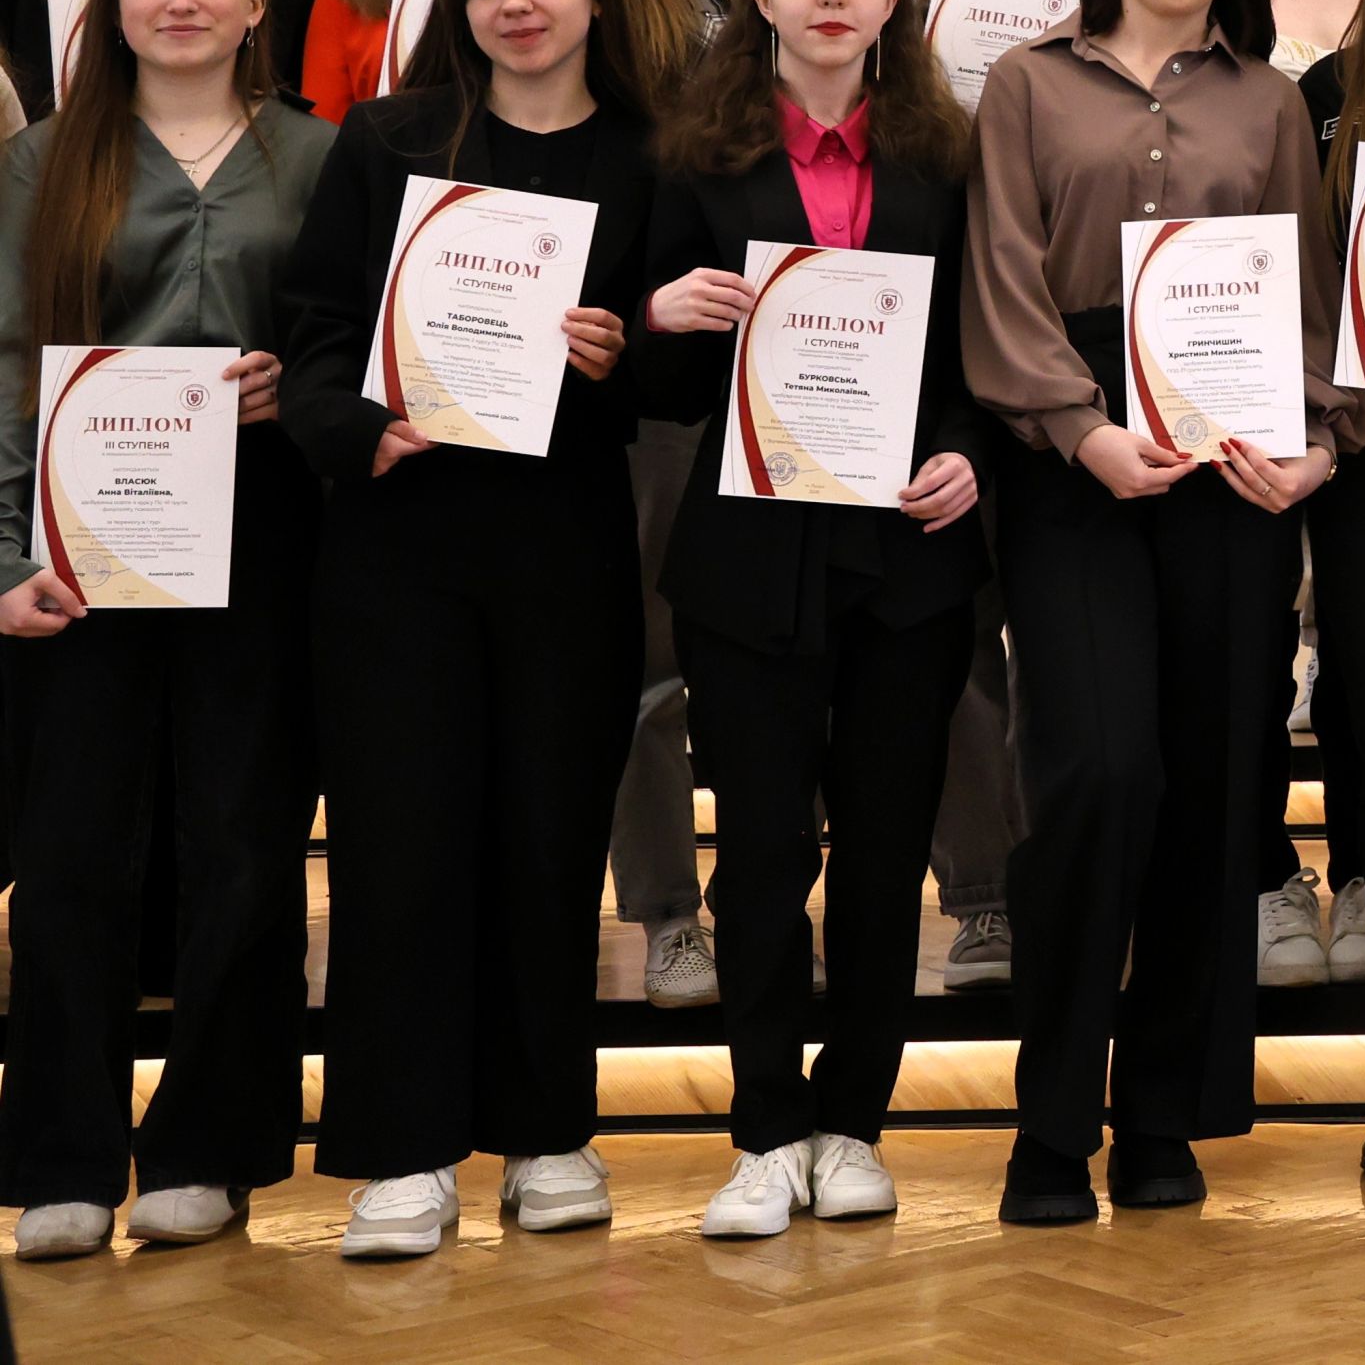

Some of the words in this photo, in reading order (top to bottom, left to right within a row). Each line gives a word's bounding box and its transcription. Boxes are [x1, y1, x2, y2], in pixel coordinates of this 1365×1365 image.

[965, 7, 1050, 32] ДИПЛОМ
[436, 250, 541, 279] ДИПЛОМ
[463, 278, 512, 293] СТУПЕНЯ
[1164, 281, 1260, 301] ДИПЛОМ
[1194, 304, 1239, 314] СТУПЕНЯ
[447, 312, 509, 328] ТАБОРОВЕЦЬ
[783, 312, 886, 335] ДИПЛОМ
[427, 321, 449, 330] Юлія
[451, 323, 524, 342] Володимирівна,
[810, 339, 859, 350] СТУПЕНЯ
[1188, 338, 1242, 347] ГРИНЧИШИН
[1168, 350, 1209, 359] Христина
[799, 373, 857, 384] БУРКОВСЬКА
[784, 383, 814, 392] Тетяна
[816, 384, 870, 397] Миколаївна,
[84, 417, 192, 433] ДИПЛОМ
[118, 441, 169, 450] СТУПЕНЯ
[124, 488, 173, 497] Віталіївна,
